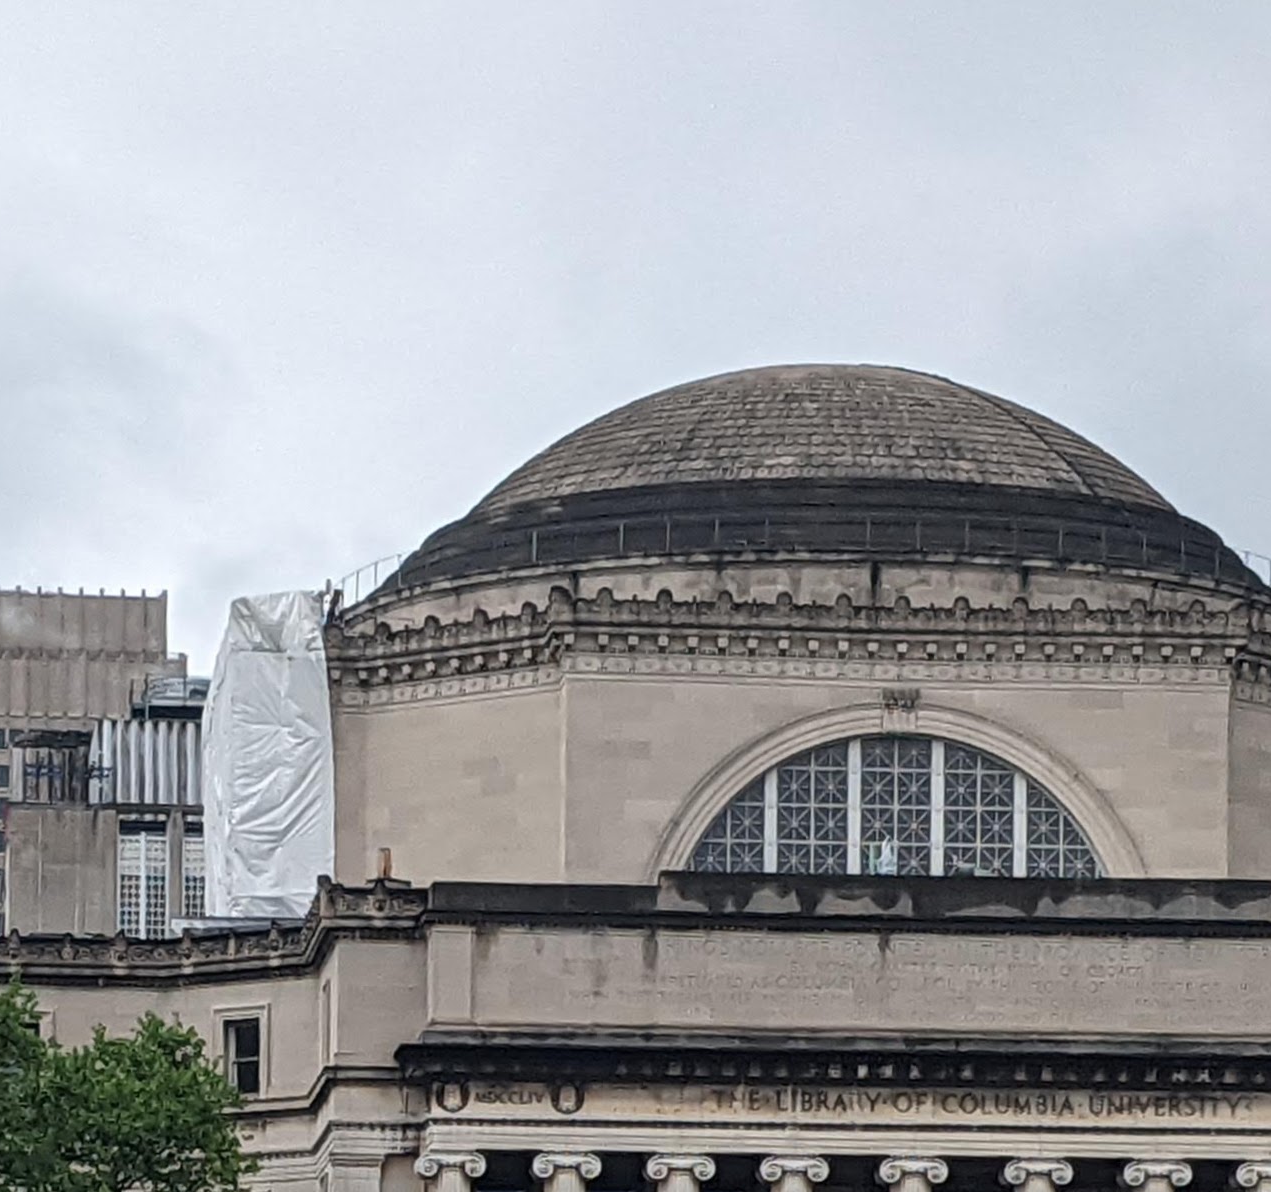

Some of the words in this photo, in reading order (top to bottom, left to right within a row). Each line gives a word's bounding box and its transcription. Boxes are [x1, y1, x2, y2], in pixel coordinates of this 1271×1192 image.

[711, 1089, 761, 1112] THE
[776, 1089, 881, 1113] LIBRARY
[892, 1091, 928, 1114] OF
[941, 1092, 1075, 1116] COLUMBIA
[1088, 1094, 1242, 1118] UNIVERSITY
